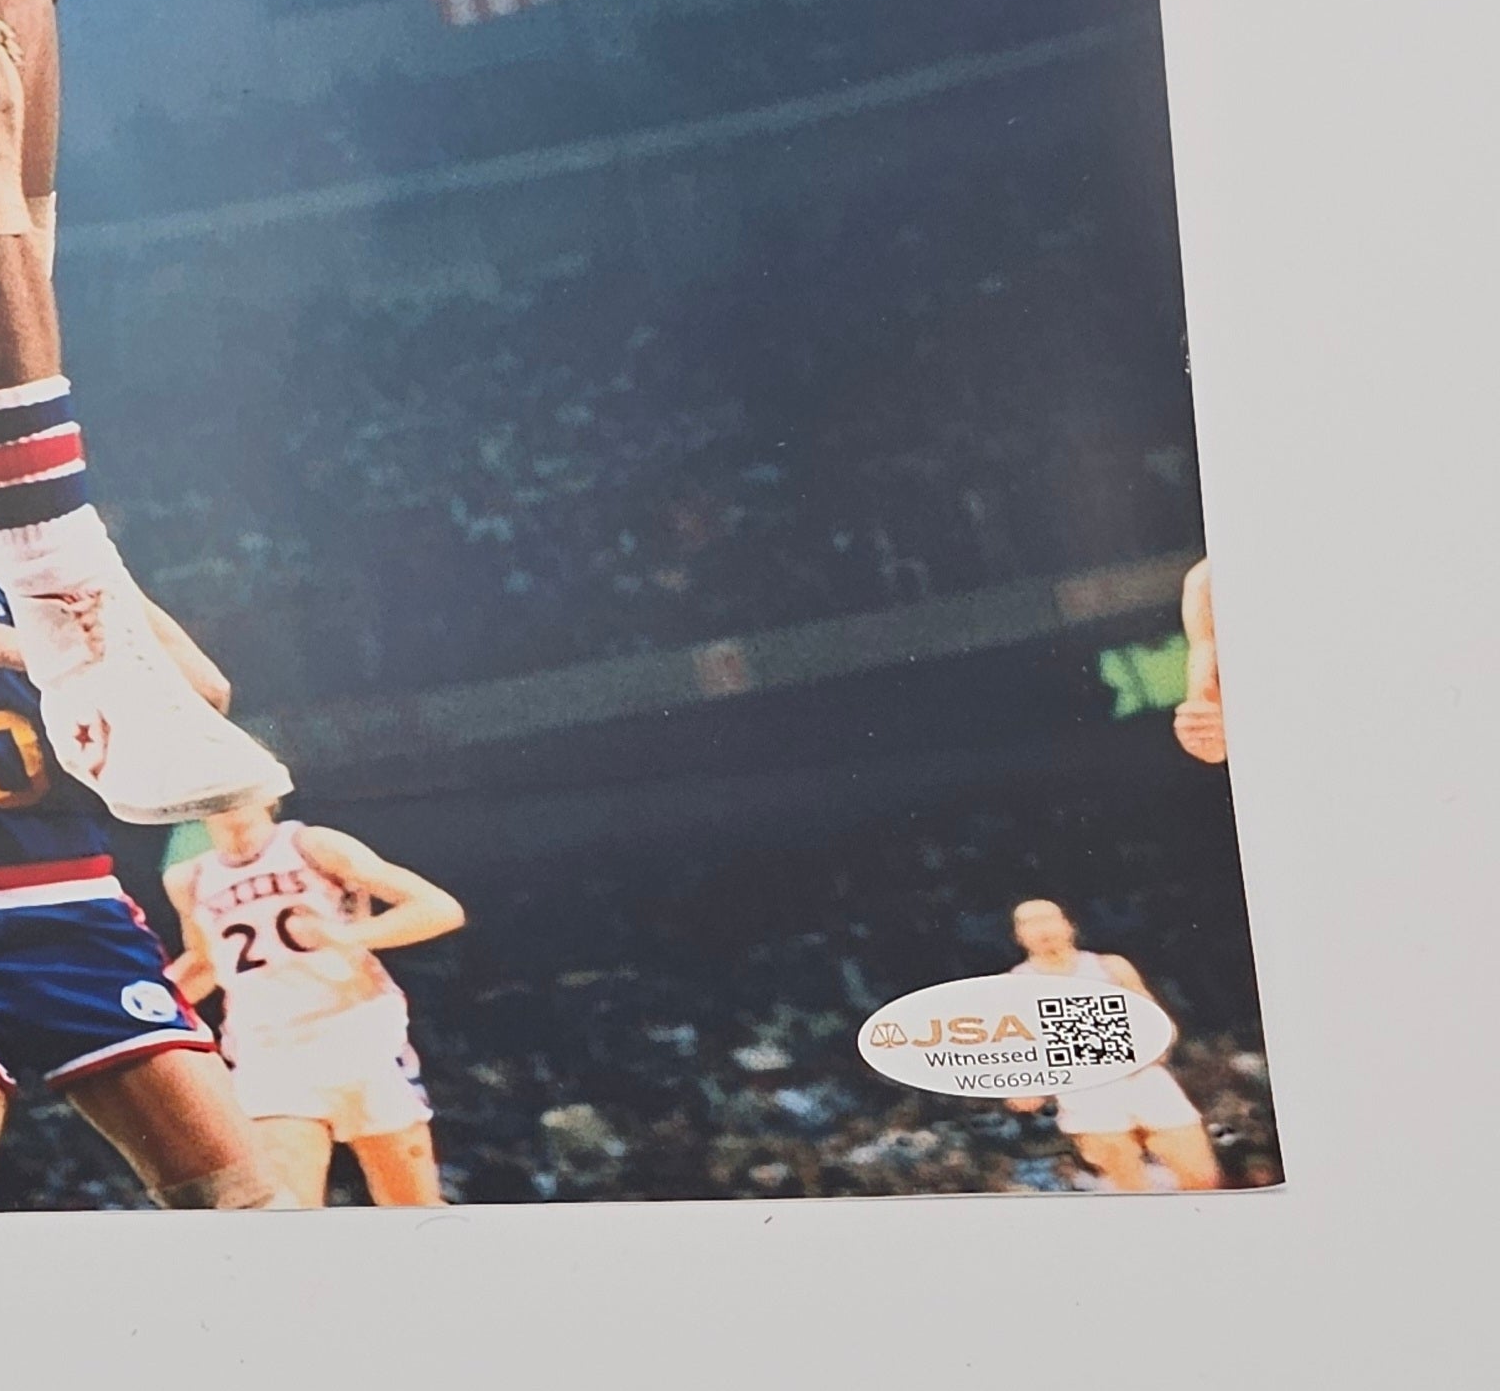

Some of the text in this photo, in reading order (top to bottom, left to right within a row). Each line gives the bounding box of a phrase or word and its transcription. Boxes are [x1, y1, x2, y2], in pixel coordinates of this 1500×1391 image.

[911, 1014, 1036, 1048] JSA
[925, 1047, 1038, 1067] Witnessed
[955, 1069, 1073, 1090] WC669452
